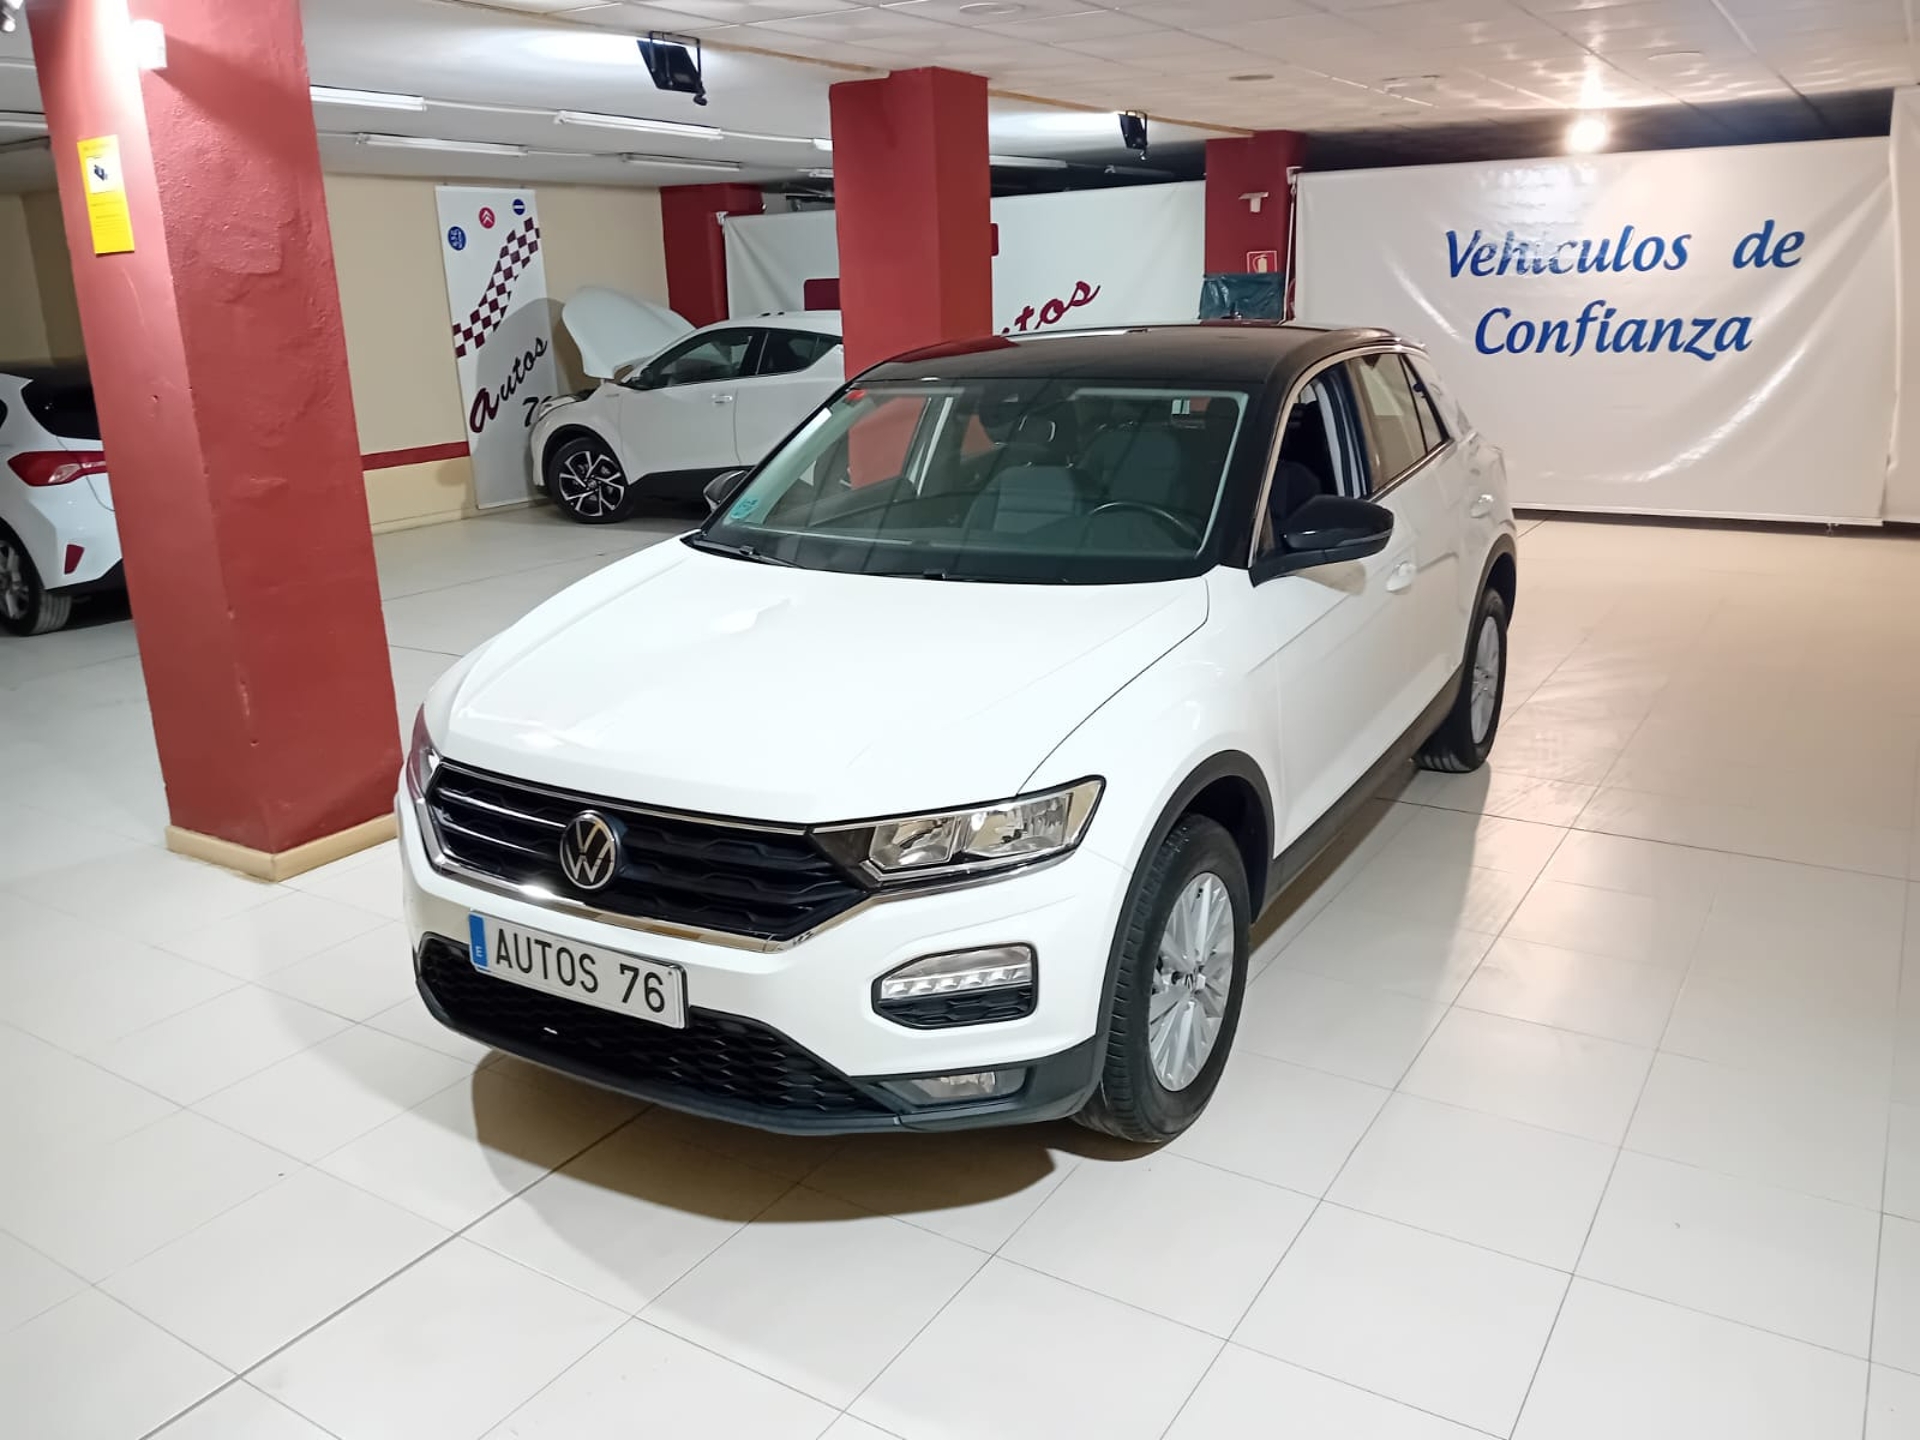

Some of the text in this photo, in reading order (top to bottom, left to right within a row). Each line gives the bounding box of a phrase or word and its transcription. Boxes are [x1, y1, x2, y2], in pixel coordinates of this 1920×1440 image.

[1732, 219, 1805, 269] de
[1001, 280, 1101, 335] tos
[1475, 299, 1754, 361] Confianza
[496, 928, 665, 1014] AUTOS 76
